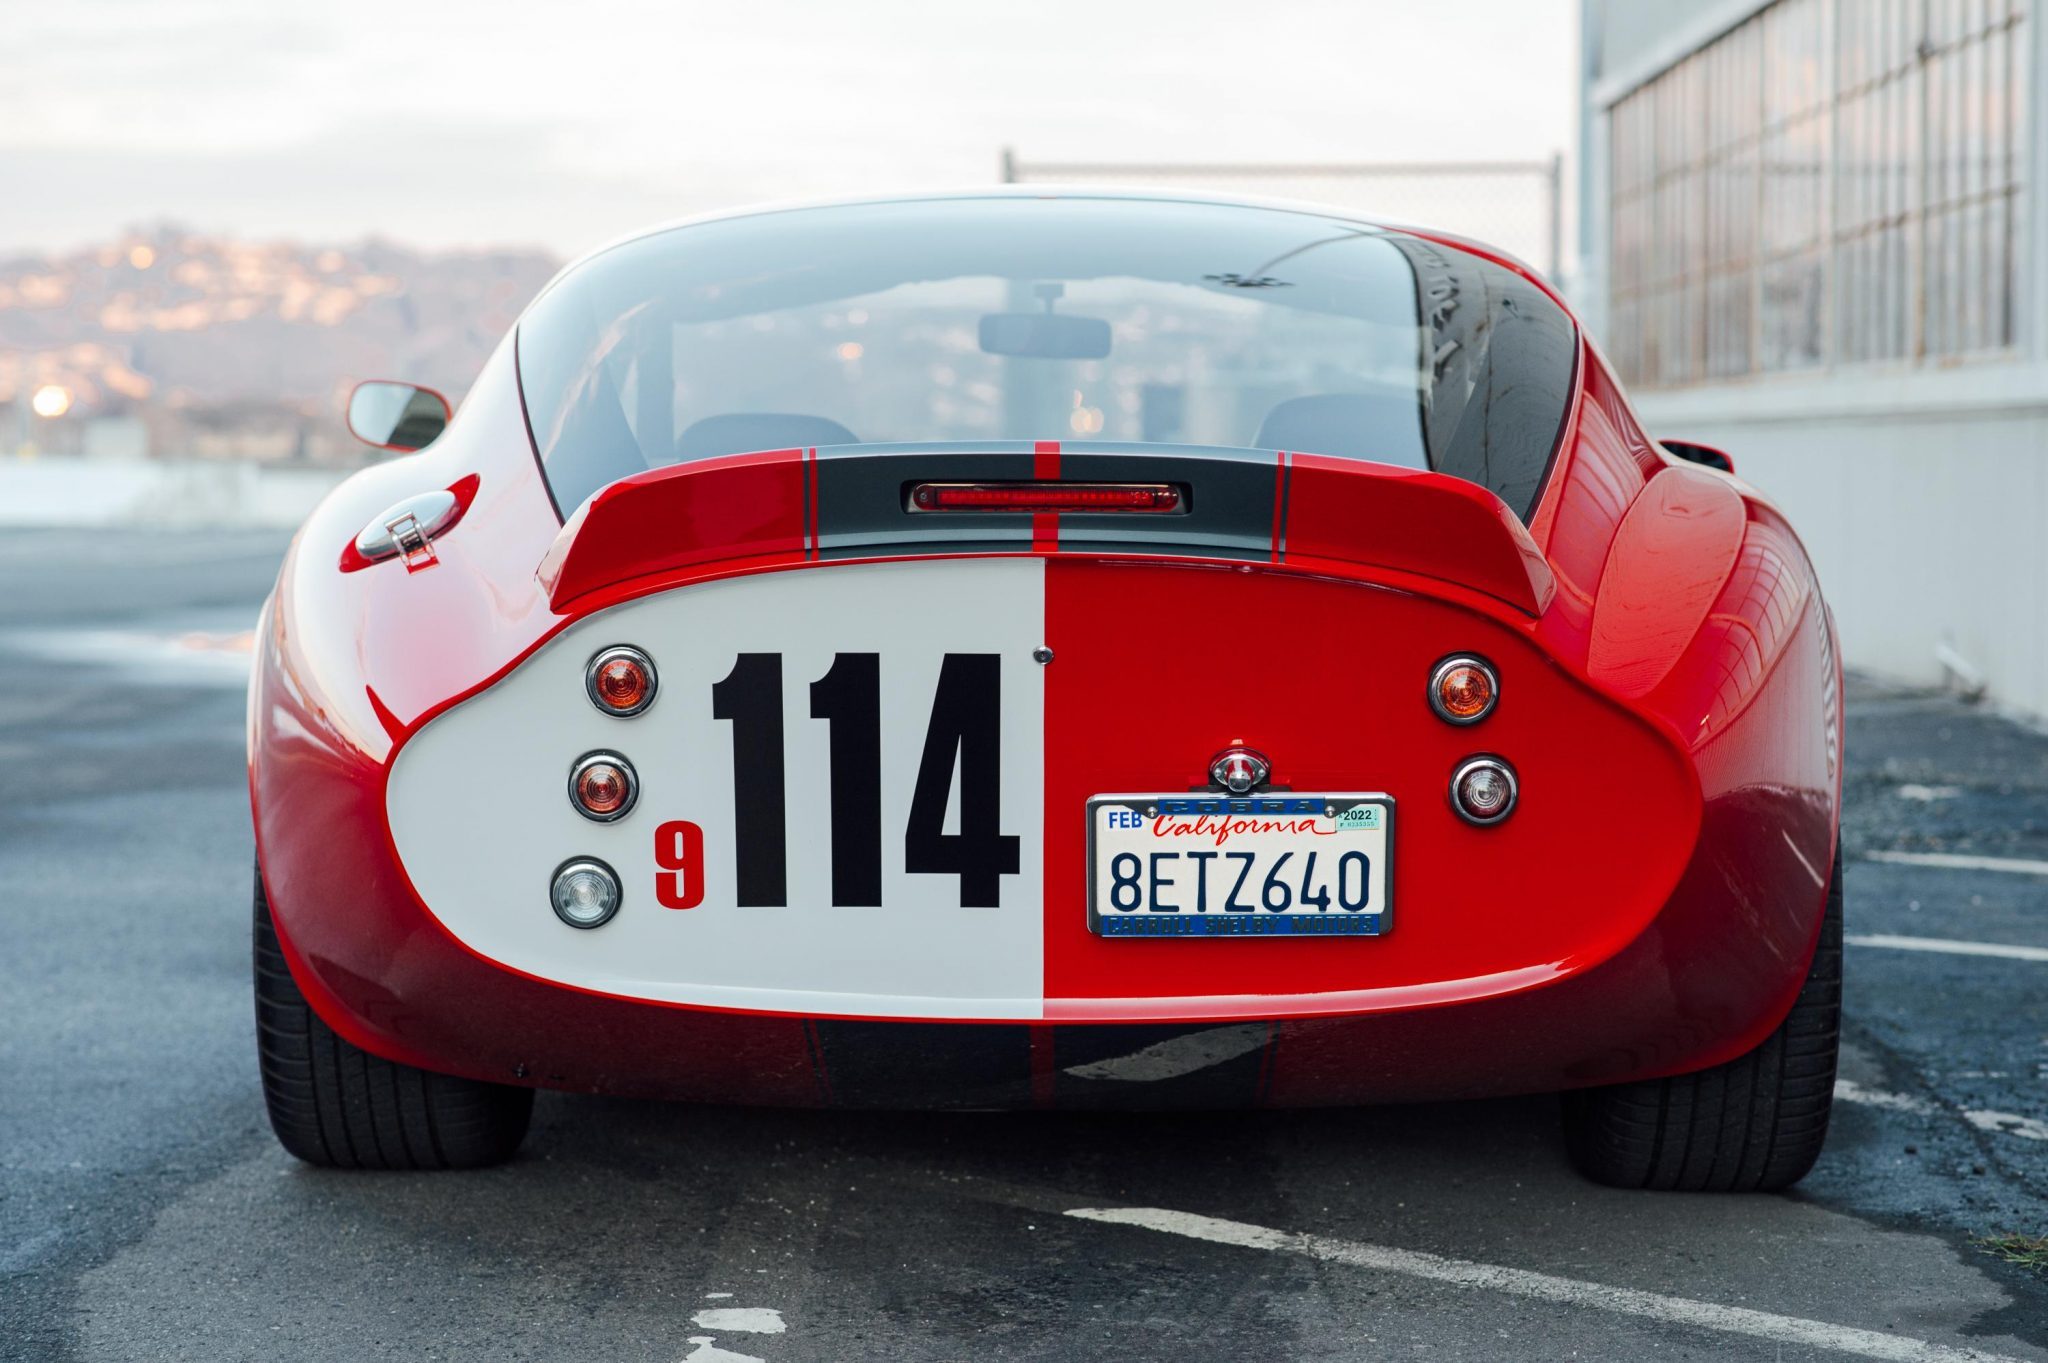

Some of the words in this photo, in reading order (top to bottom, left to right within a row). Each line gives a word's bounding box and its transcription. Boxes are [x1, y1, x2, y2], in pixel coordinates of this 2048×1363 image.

[712, 653, 1020, 908] 114
[1108, 812, 1142, 829] FEB
[1152, 815, 1338, 846] California
[1343, 809, 1373, 820] 2022
[1164, 800, 1316, 812] COBRA
[655, 820, 704, 909] 9
[1110, 851, 1371, 913] 8ETZ640
[1108, 916, 1195, 934] CARROLL
[1206, 916, 1278, 934] SHELBY
[1292, 916, 1373, 934] MOTORS
